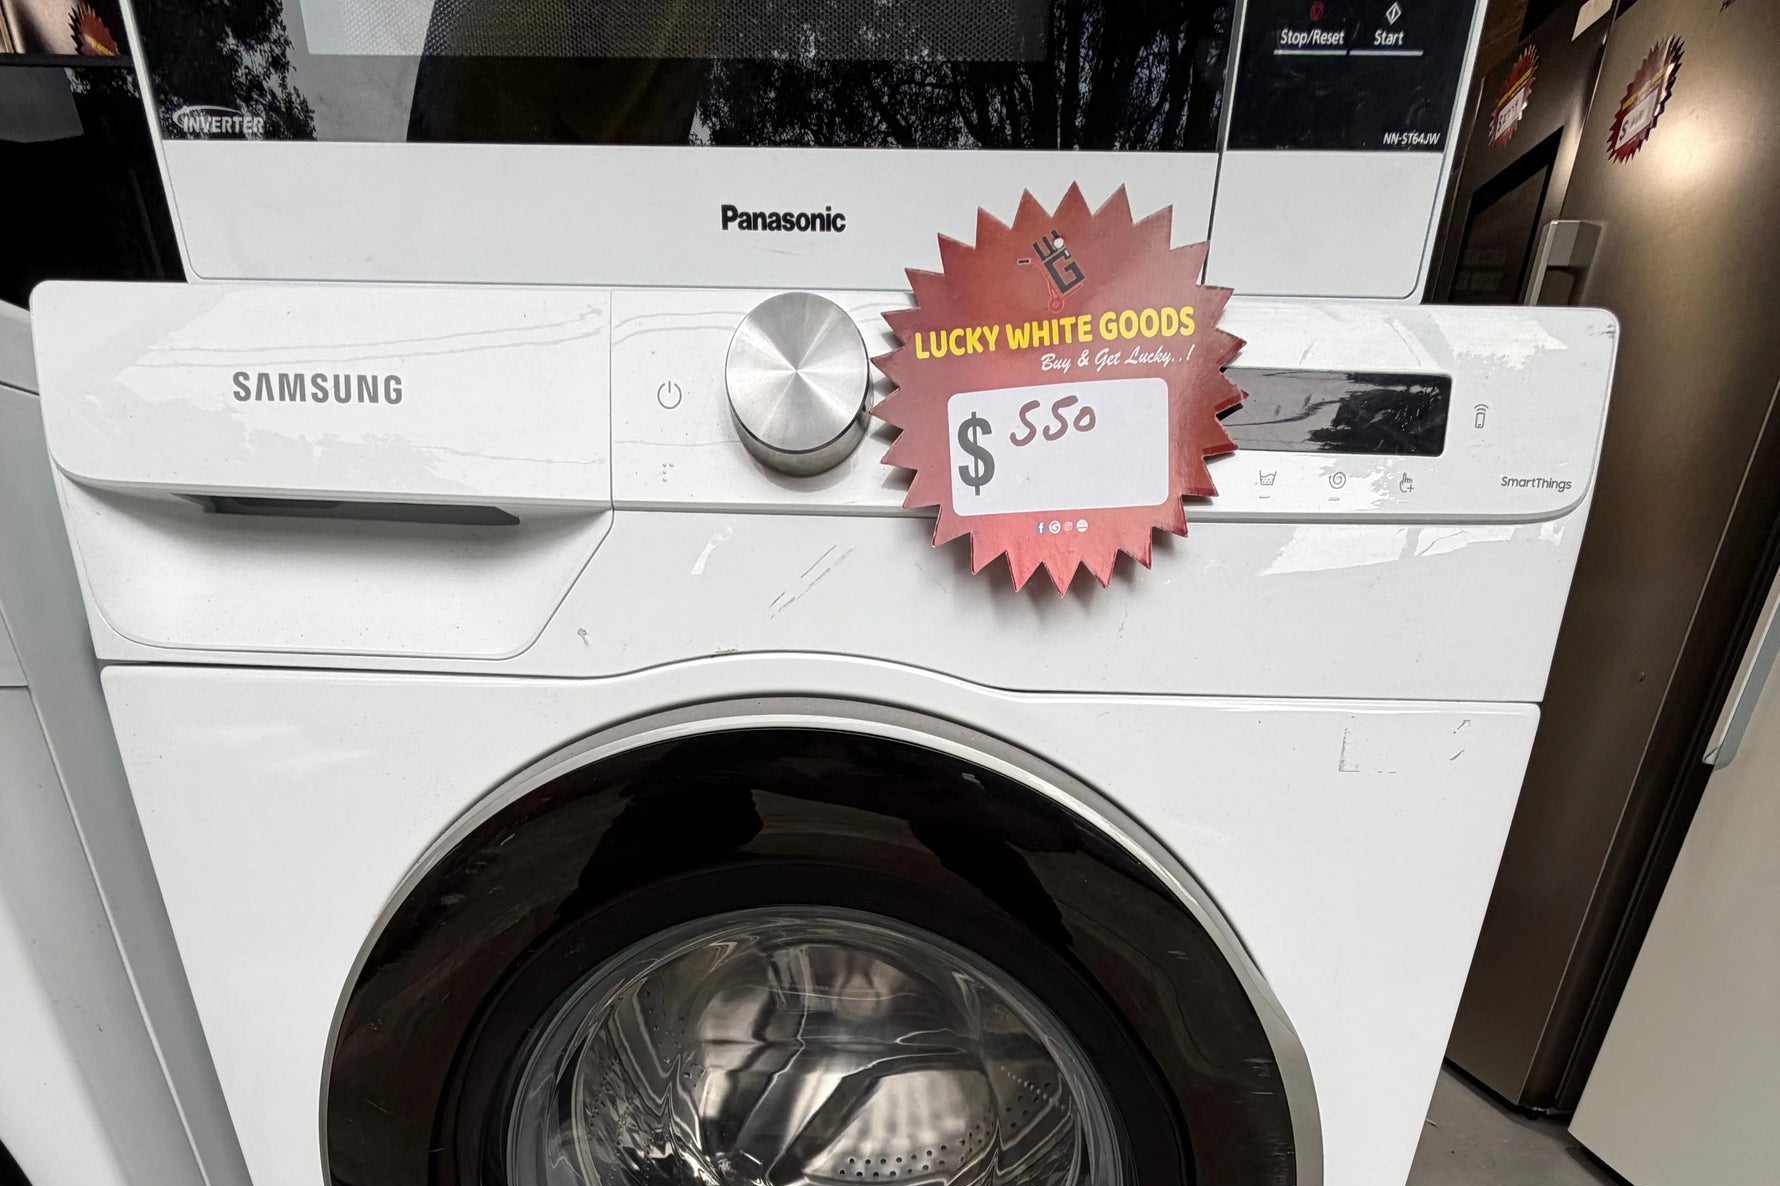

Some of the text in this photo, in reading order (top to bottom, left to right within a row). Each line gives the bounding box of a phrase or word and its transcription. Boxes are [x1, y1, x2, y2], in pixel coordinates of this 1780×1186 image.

[1280, 28, 1345, 47] Stop/Reset
[1374, 30, 1404, 46] Start
[183, 116, 265, 133] INVERTER
[1383, 132, 1441, 145] NN-ST64JW
[721, 204, 846, 233] Panasonic
[915, 306, 1196, 359] LUCKY WHITE GOODS
[1041, 353, 1071, 372] Buy
[1077, 350, 1089, 367] &
[1094, 348, 1120, 372] Get
[233, 371, 402, 405] SAMSUNG
[957, 395, 1096, 496] $ 550
[1501, 476, 1572, 493] SmartThings
